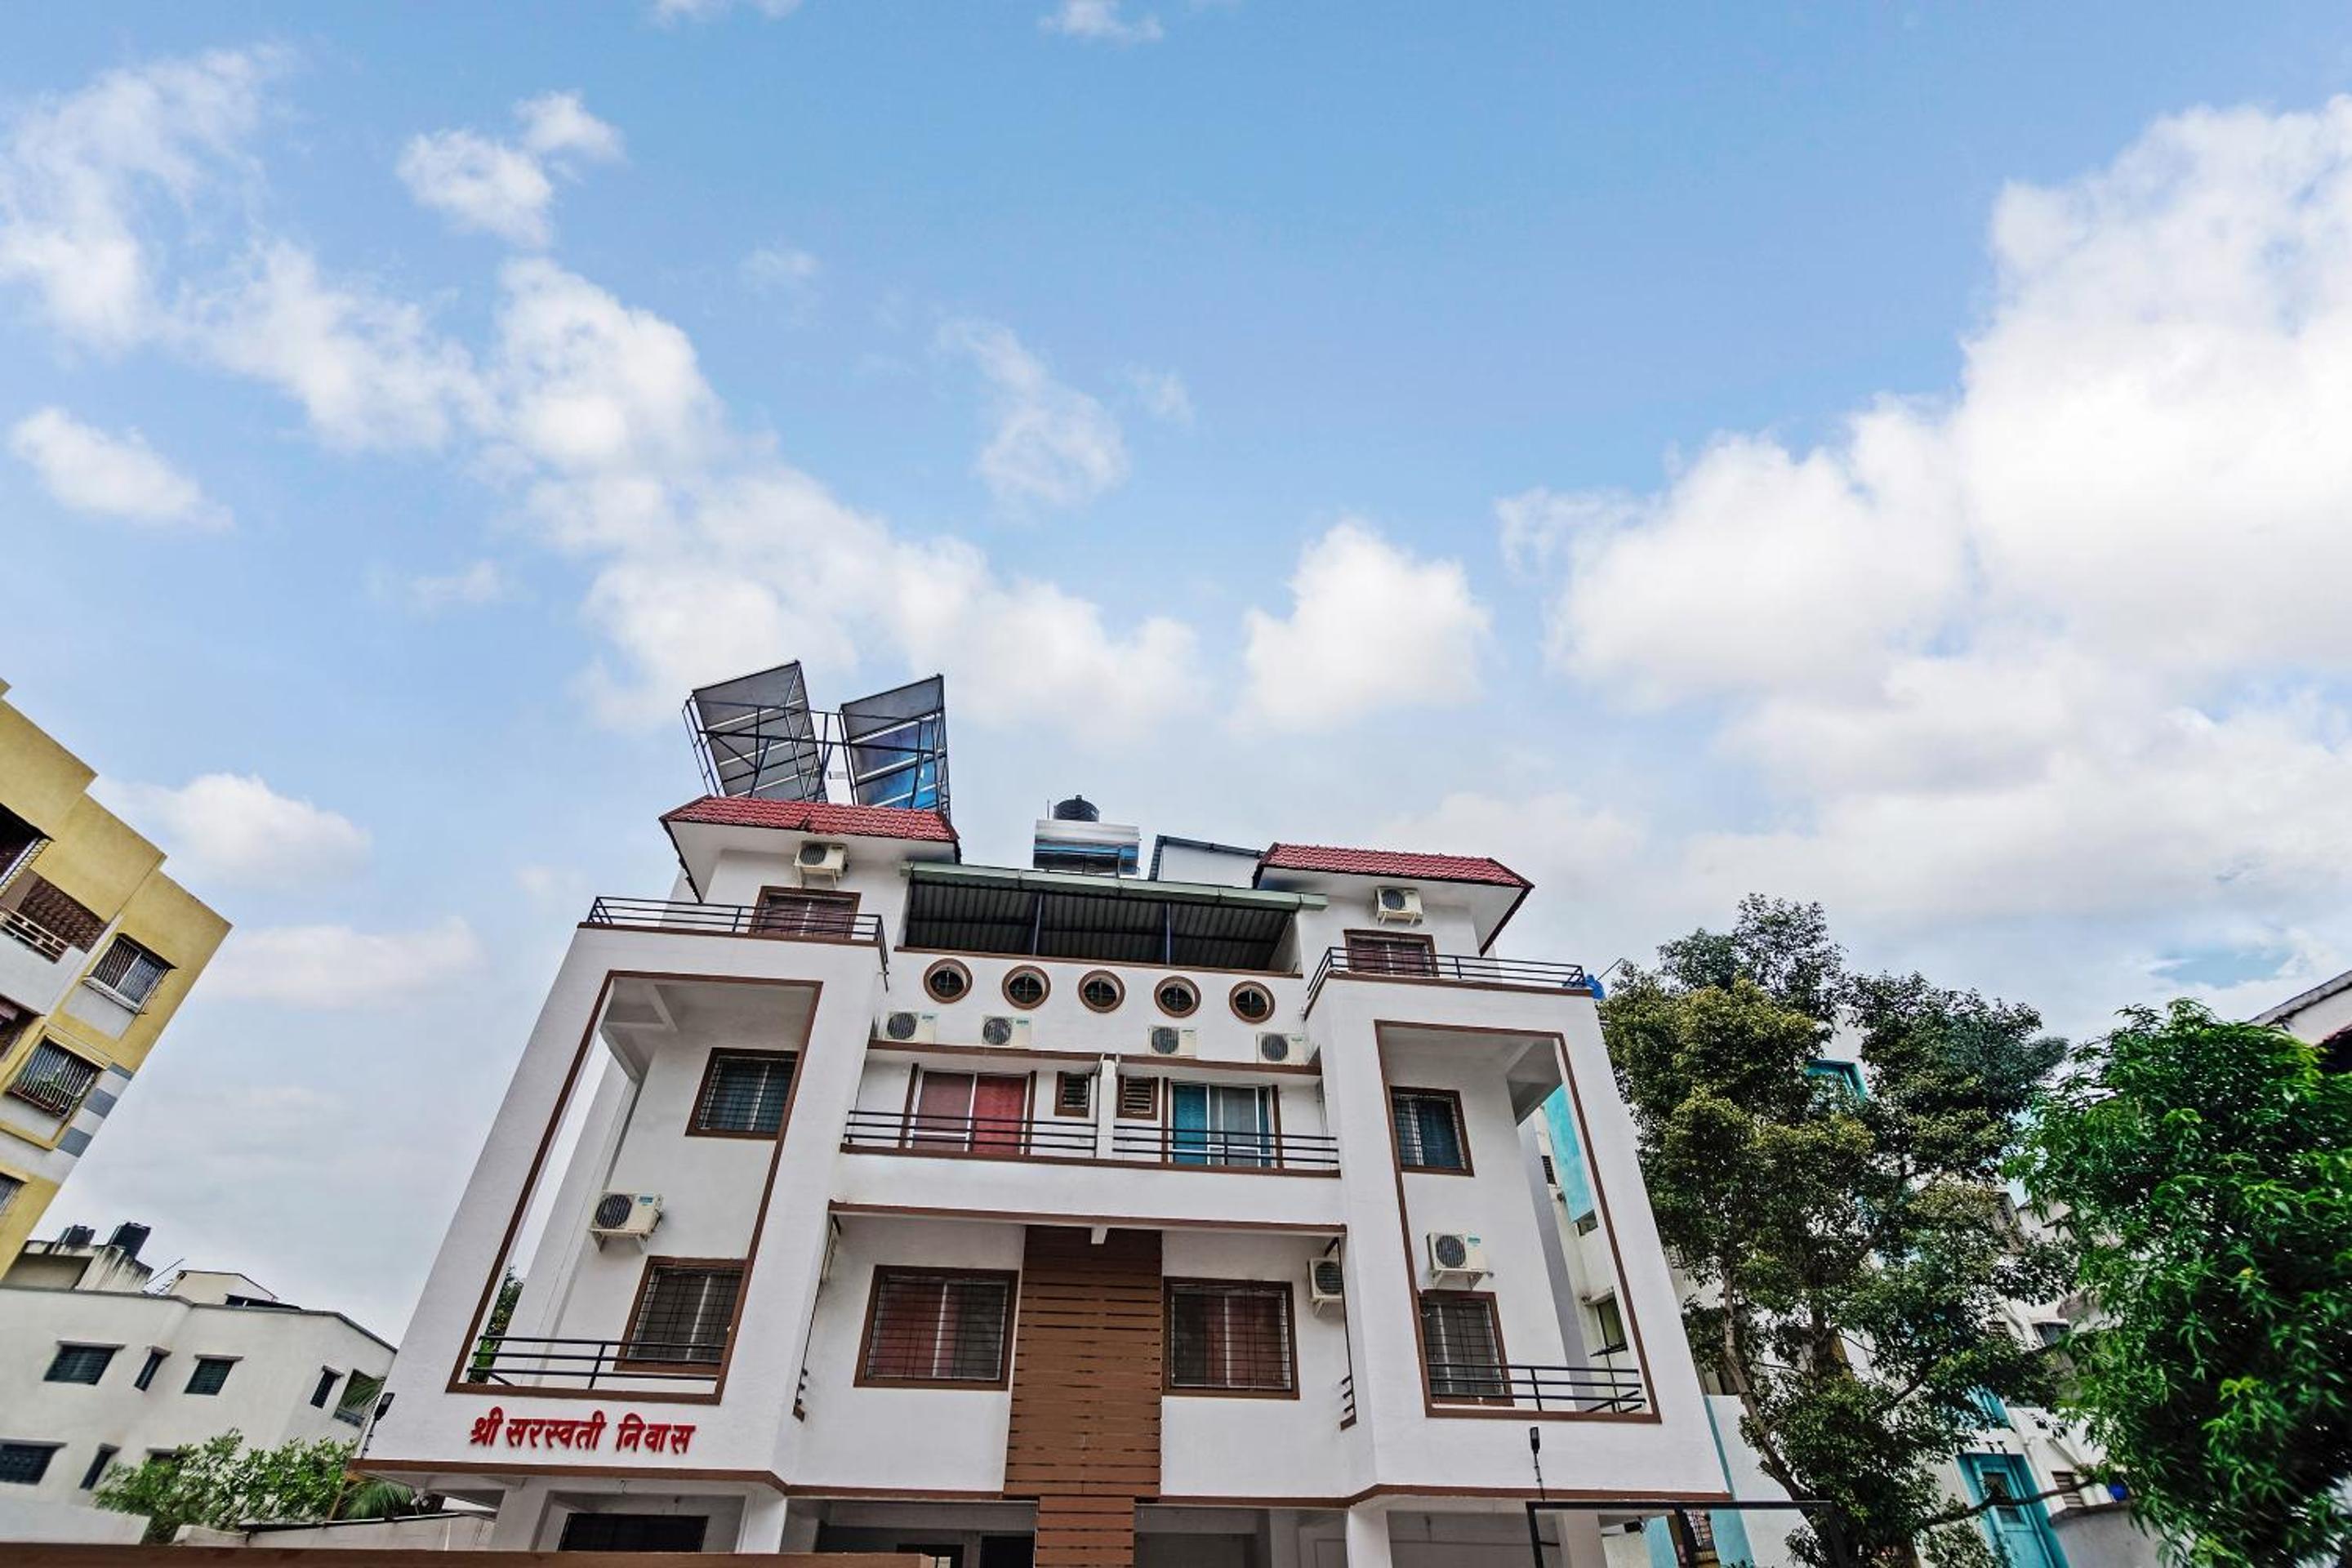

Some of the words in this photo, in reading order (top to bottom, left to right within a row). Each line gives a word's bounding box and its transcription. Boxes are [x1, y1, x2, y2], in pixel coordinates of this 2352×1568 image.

[470, 1406, 504, 1447] श्री
[506, 1410, 607, 1450] सरस्वती
[616, 1413, 697, 1454] निवास
